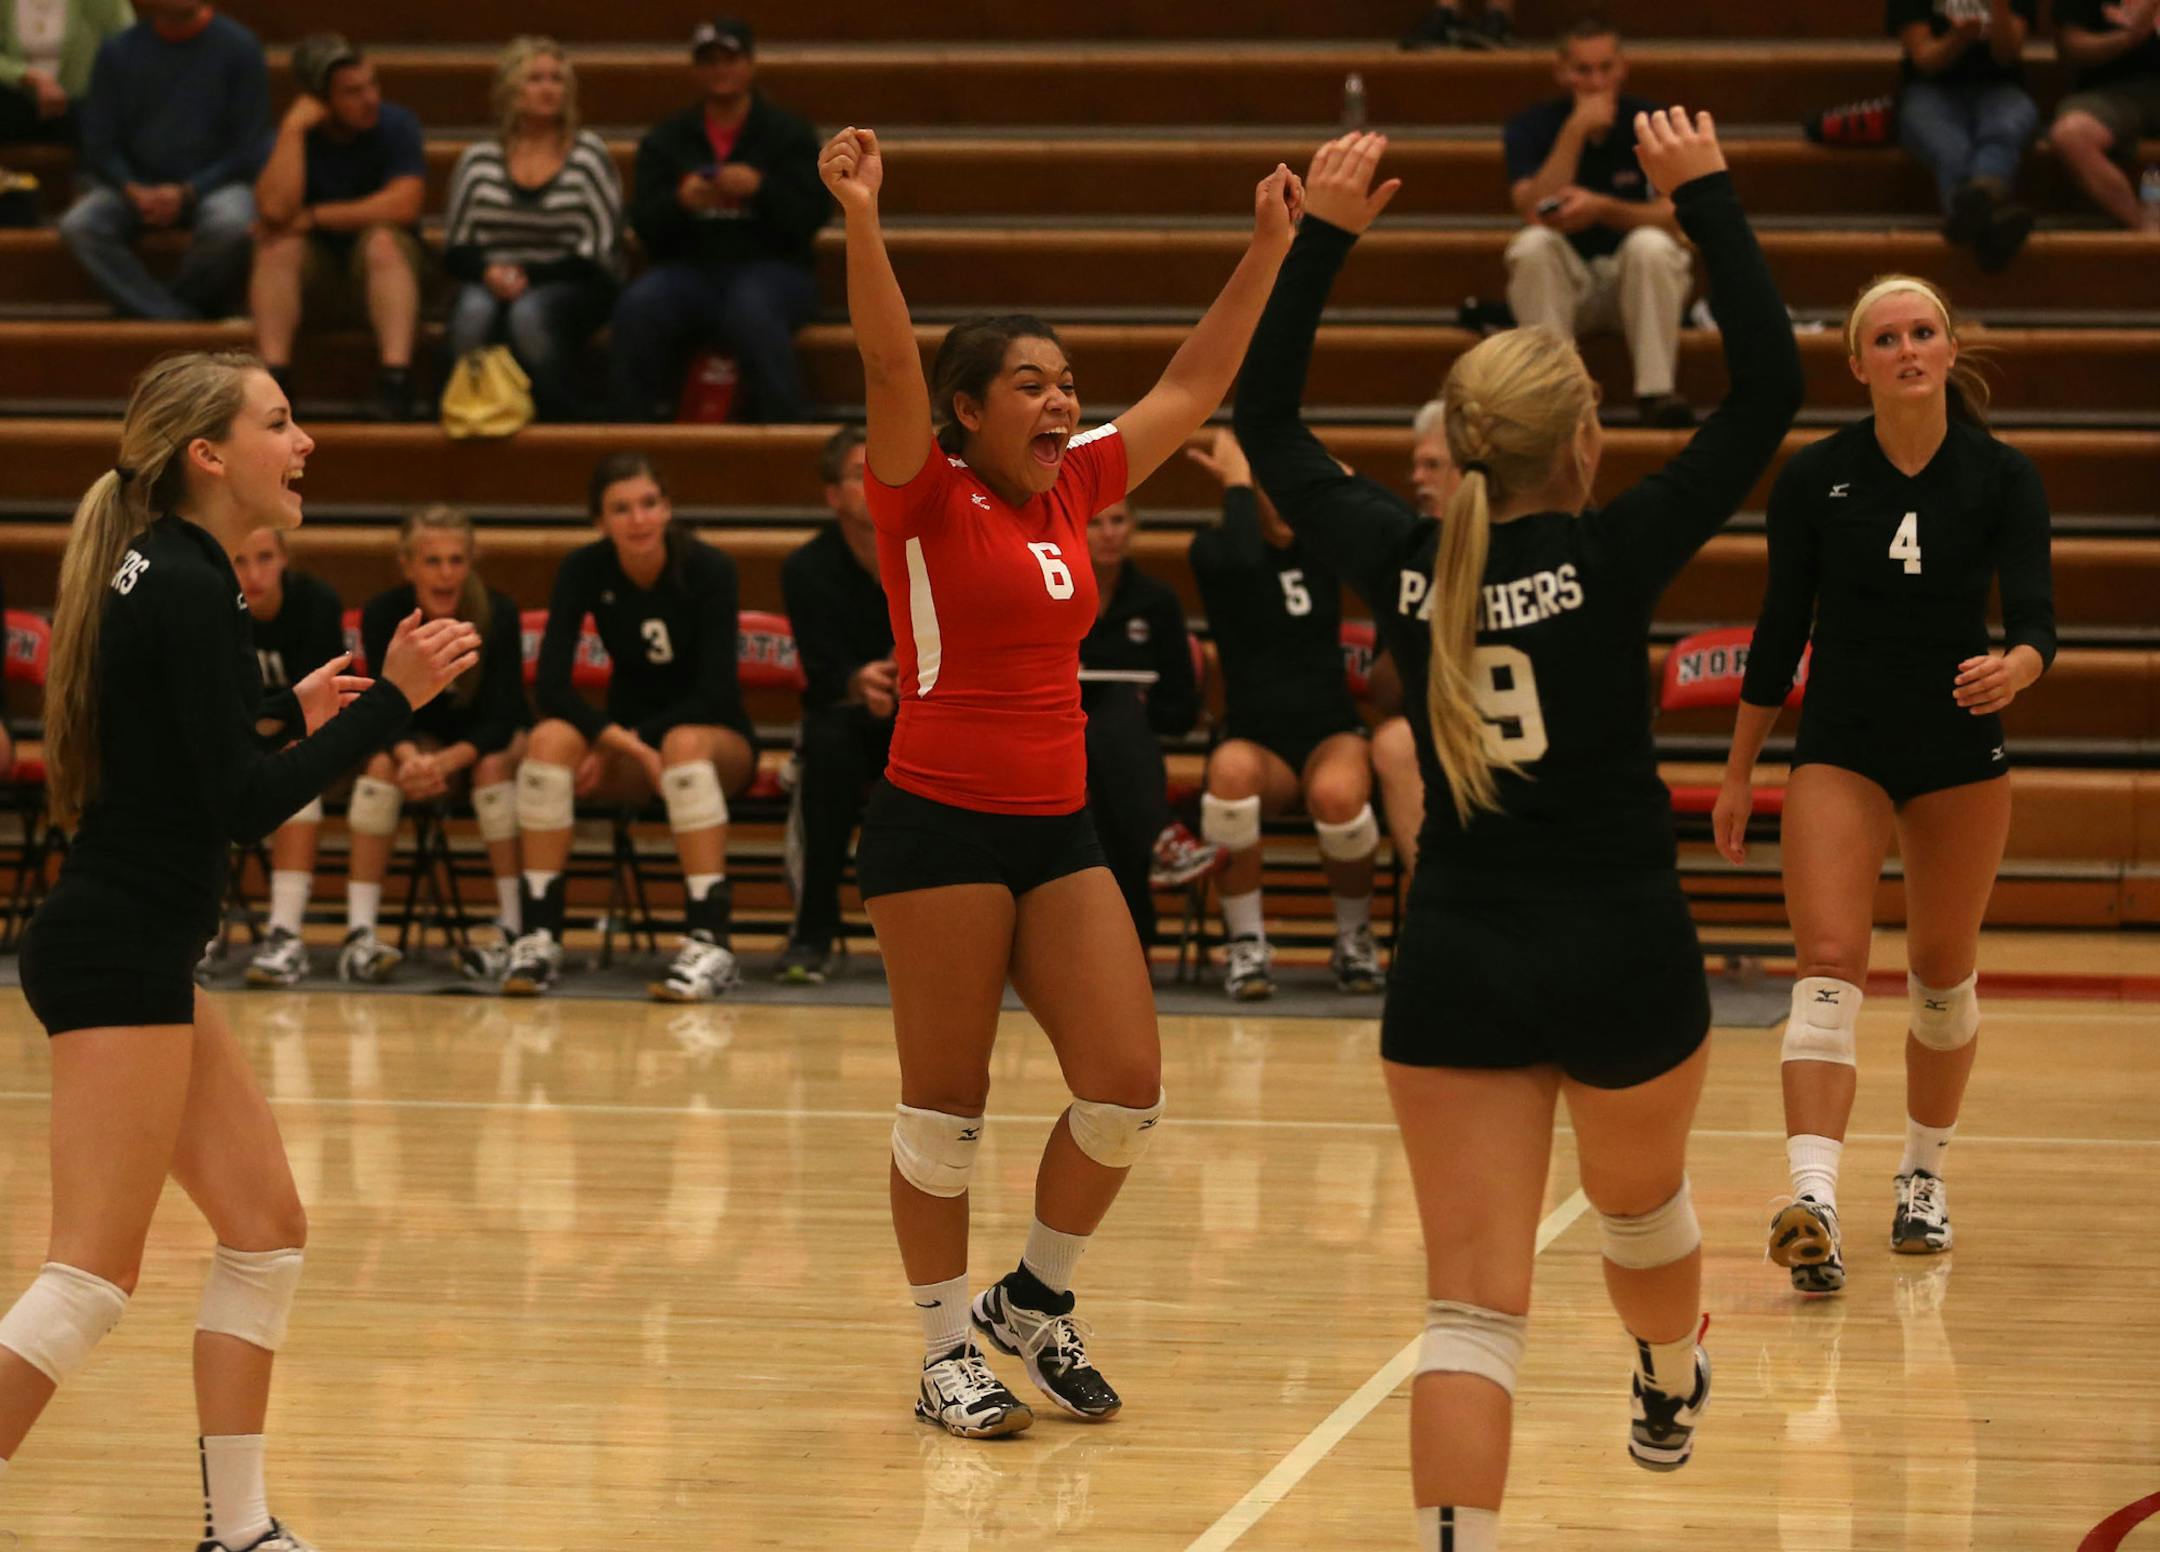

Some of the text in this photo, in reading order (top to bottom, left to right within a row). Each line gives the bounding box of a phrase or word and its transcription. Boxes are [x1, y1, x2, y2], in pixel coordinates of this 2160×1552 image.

[1027, 542, 1075, 600] 6
[1889, 512, 1921, 574] 4
[1279, 569, 1312, 616] 5
[1398, 563, 1584, 631] PHERS
[641, 618, 673, 664] 3
[1473, 645, 1548, 763] 9
